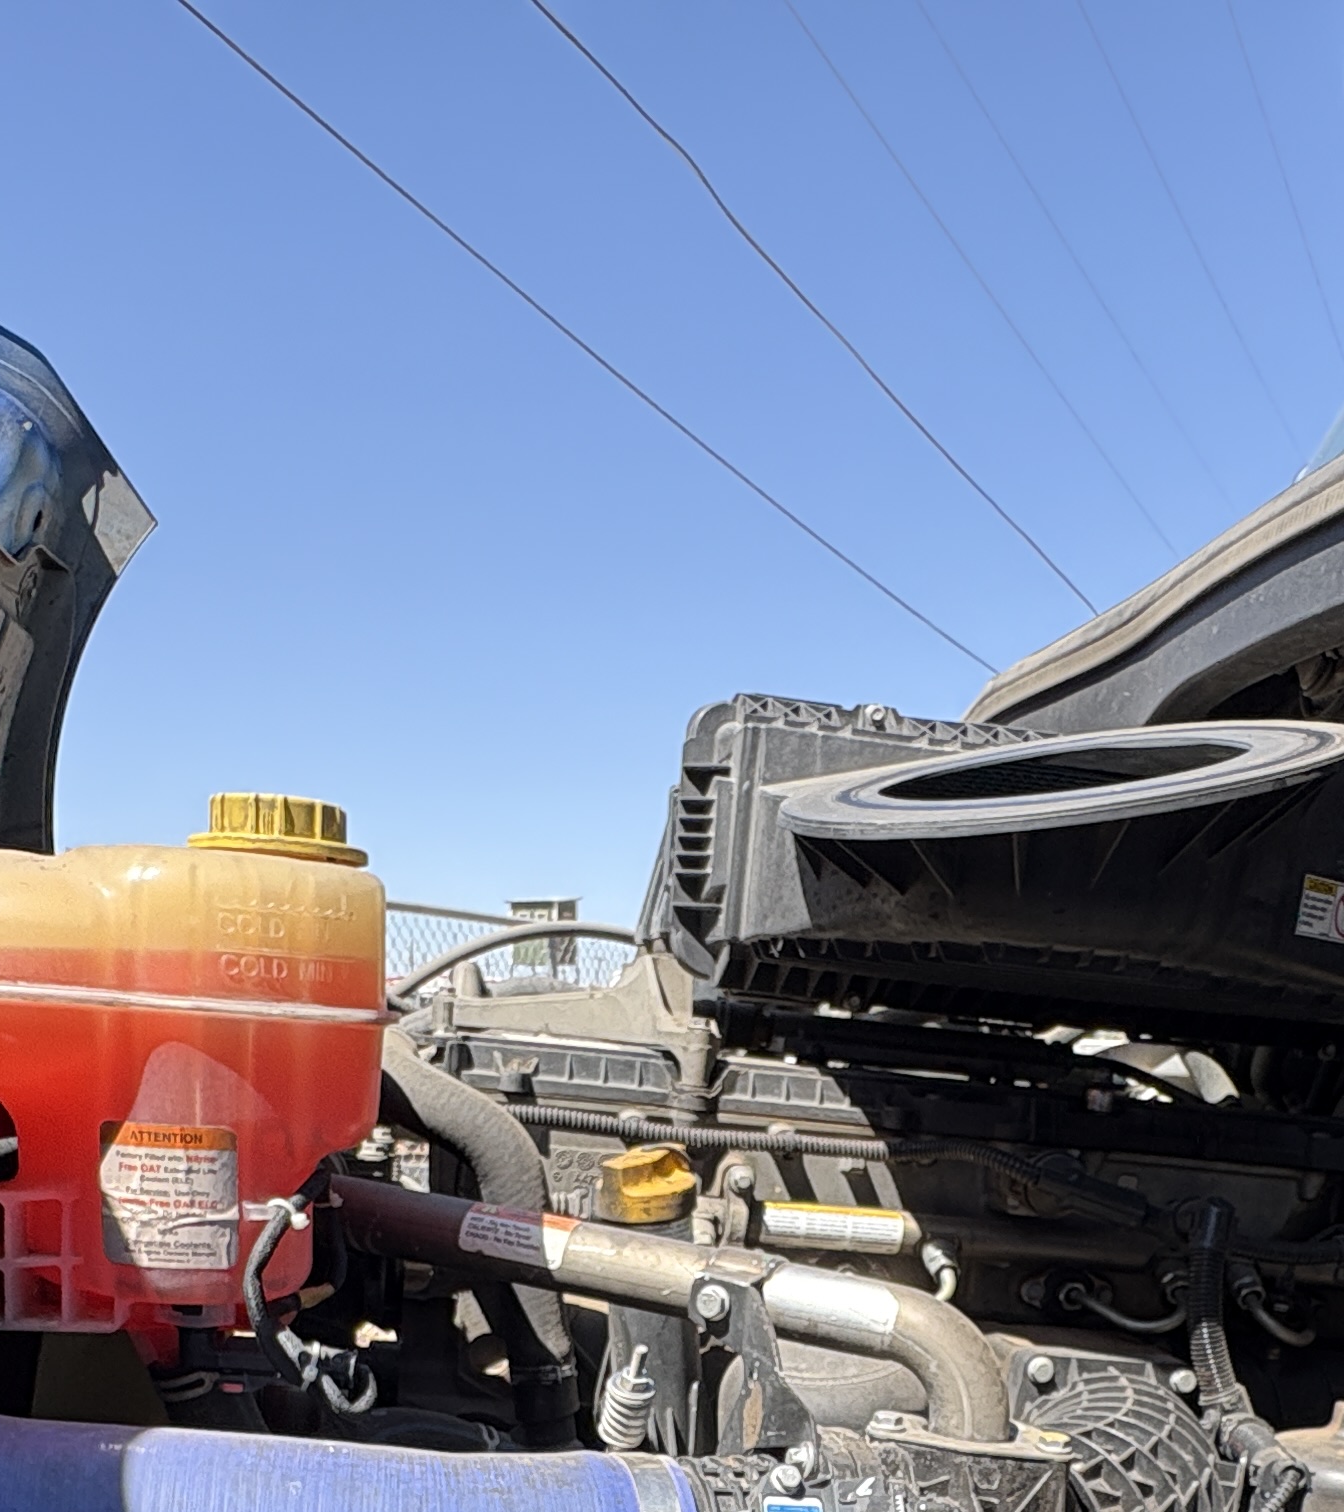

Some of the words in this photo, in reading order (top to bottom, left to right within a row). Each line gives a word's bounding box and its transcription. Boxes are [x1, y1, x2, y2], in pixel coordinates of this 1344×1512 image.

[217, 912, 286, 938] COLD
[220, 954, 288, 980] COLD
[130, 1130, 203, 1145] ATTENTION
[119, 1162, 138, 1172] Free
[140, 1163, 161, 1173] OAT
